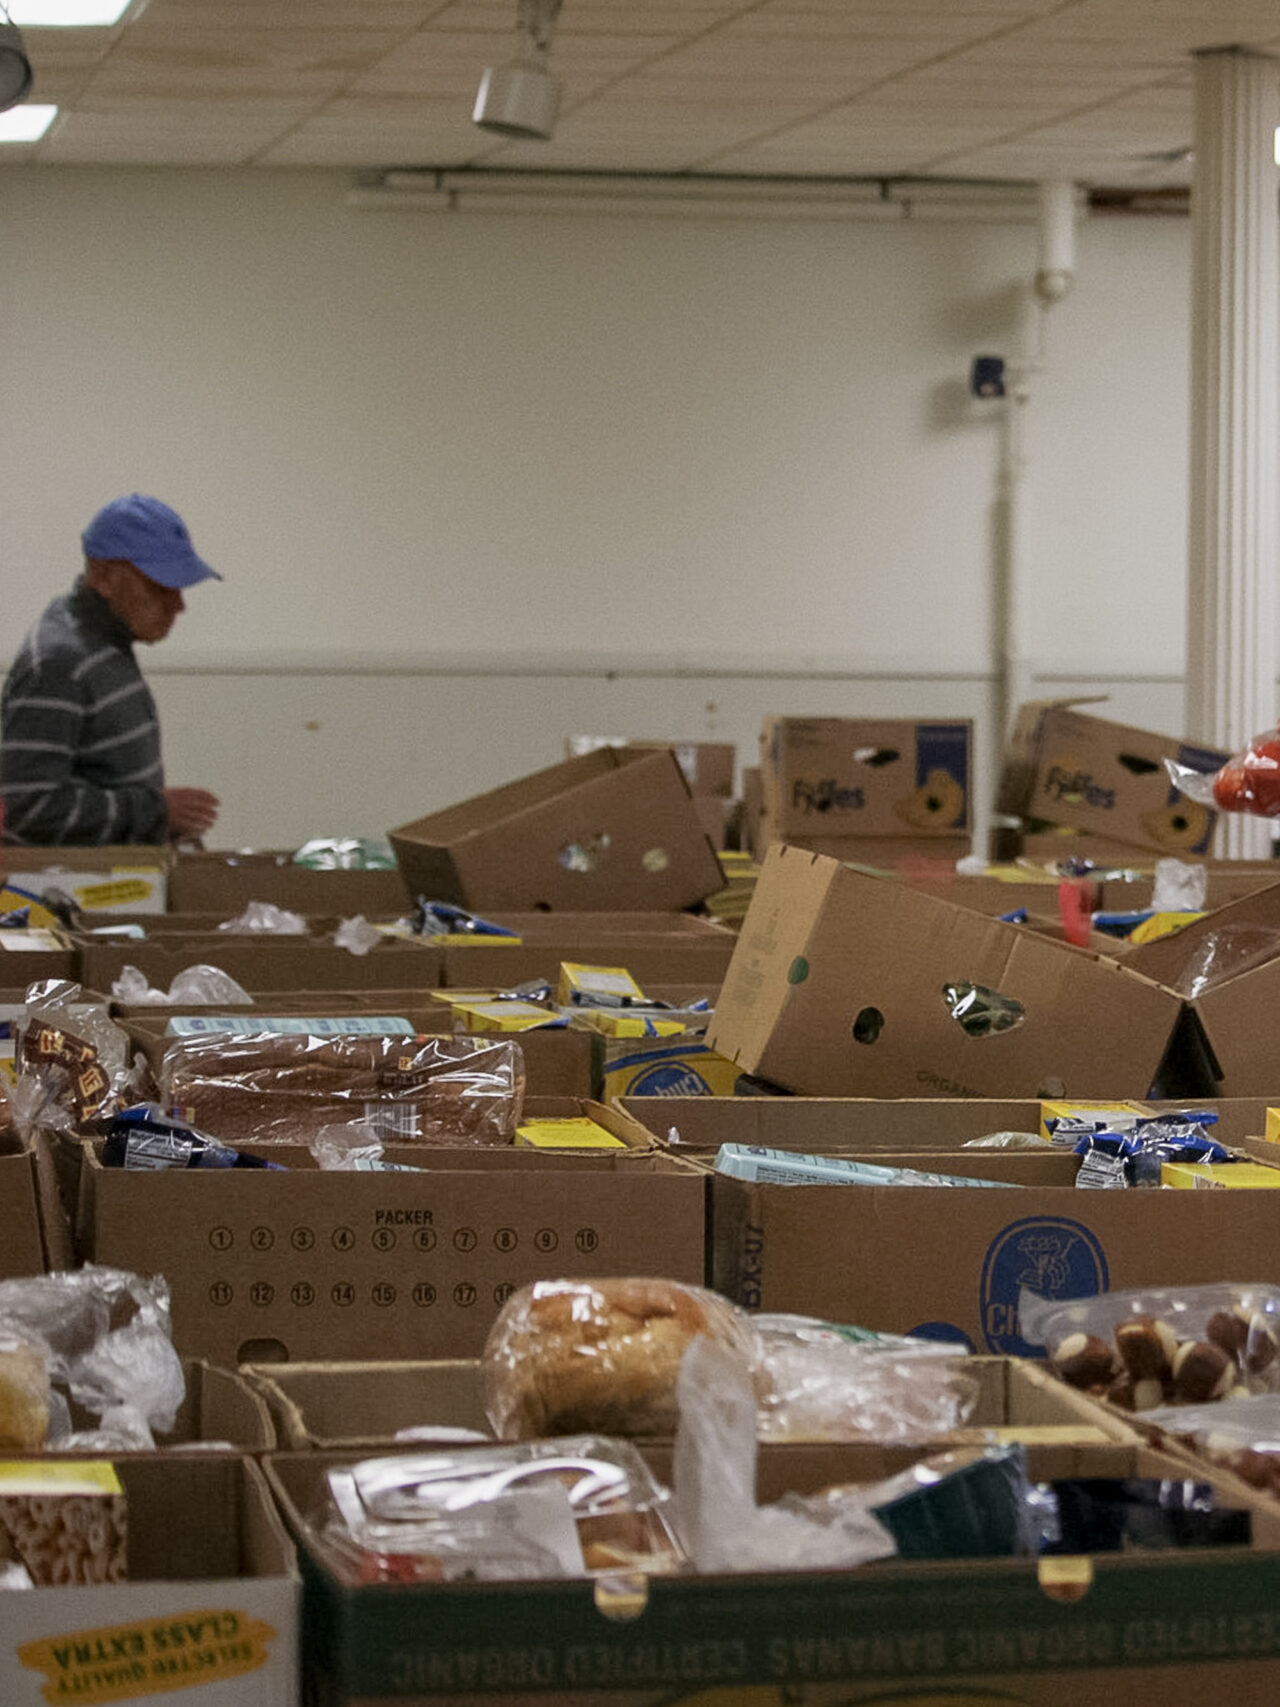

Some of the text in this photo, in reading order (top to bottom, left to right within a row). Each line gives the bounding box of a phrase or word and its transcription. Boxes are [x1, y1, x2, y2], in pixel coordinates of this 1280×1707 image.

[375, 1209, 433, 1225] PACKER
[53, 1611, 239, 1670] CLASS EXTRA
